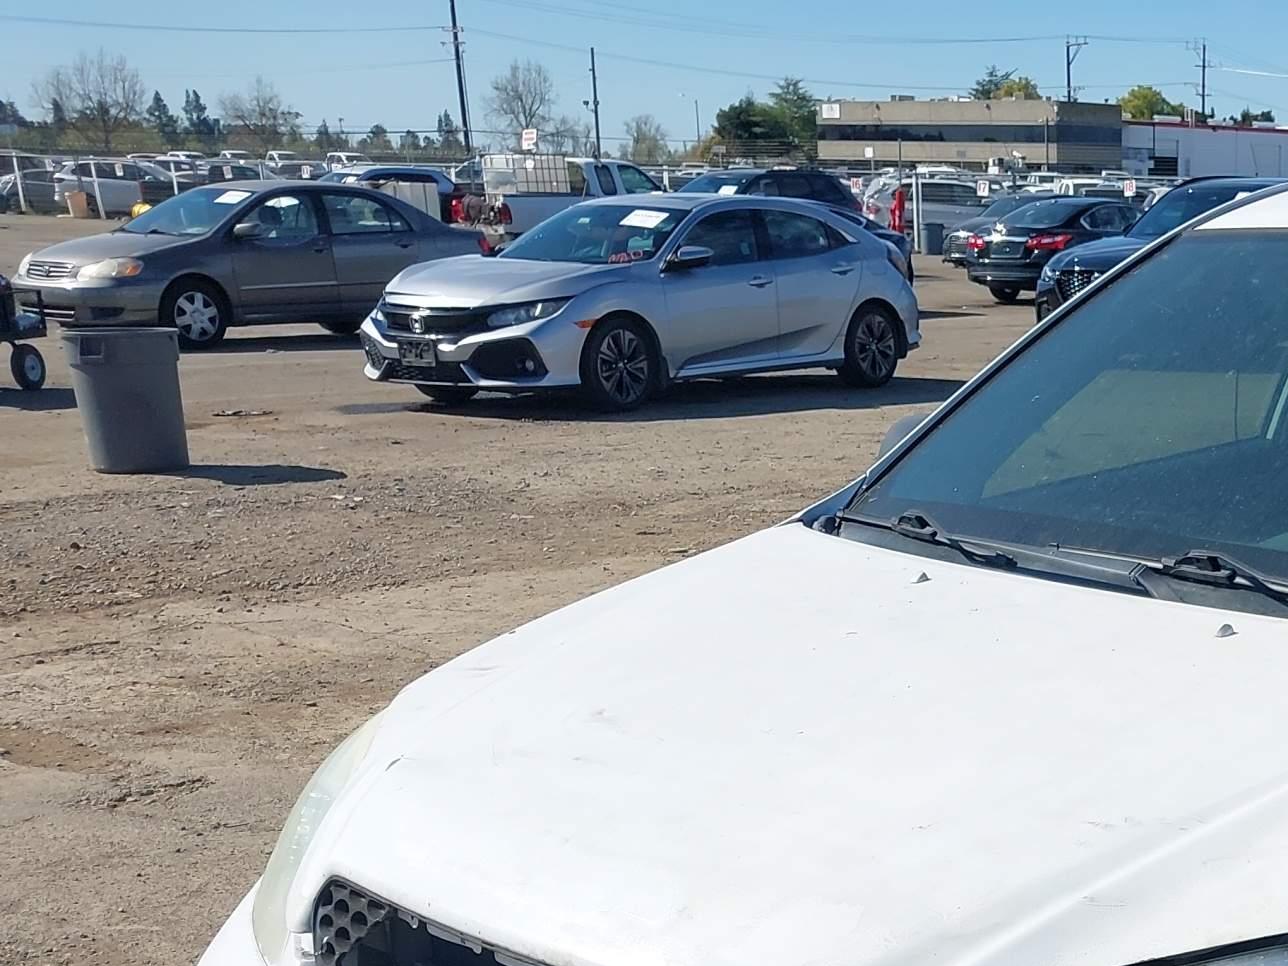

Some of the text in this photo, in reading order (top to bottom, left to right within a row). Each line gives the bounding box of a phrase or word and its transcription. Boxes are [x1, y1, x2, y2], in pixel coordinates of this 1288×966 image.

[851, 178, 861, 190] 16
[978, 182, 987, 193] 17
[1125, 181, 1134, 193] 18
